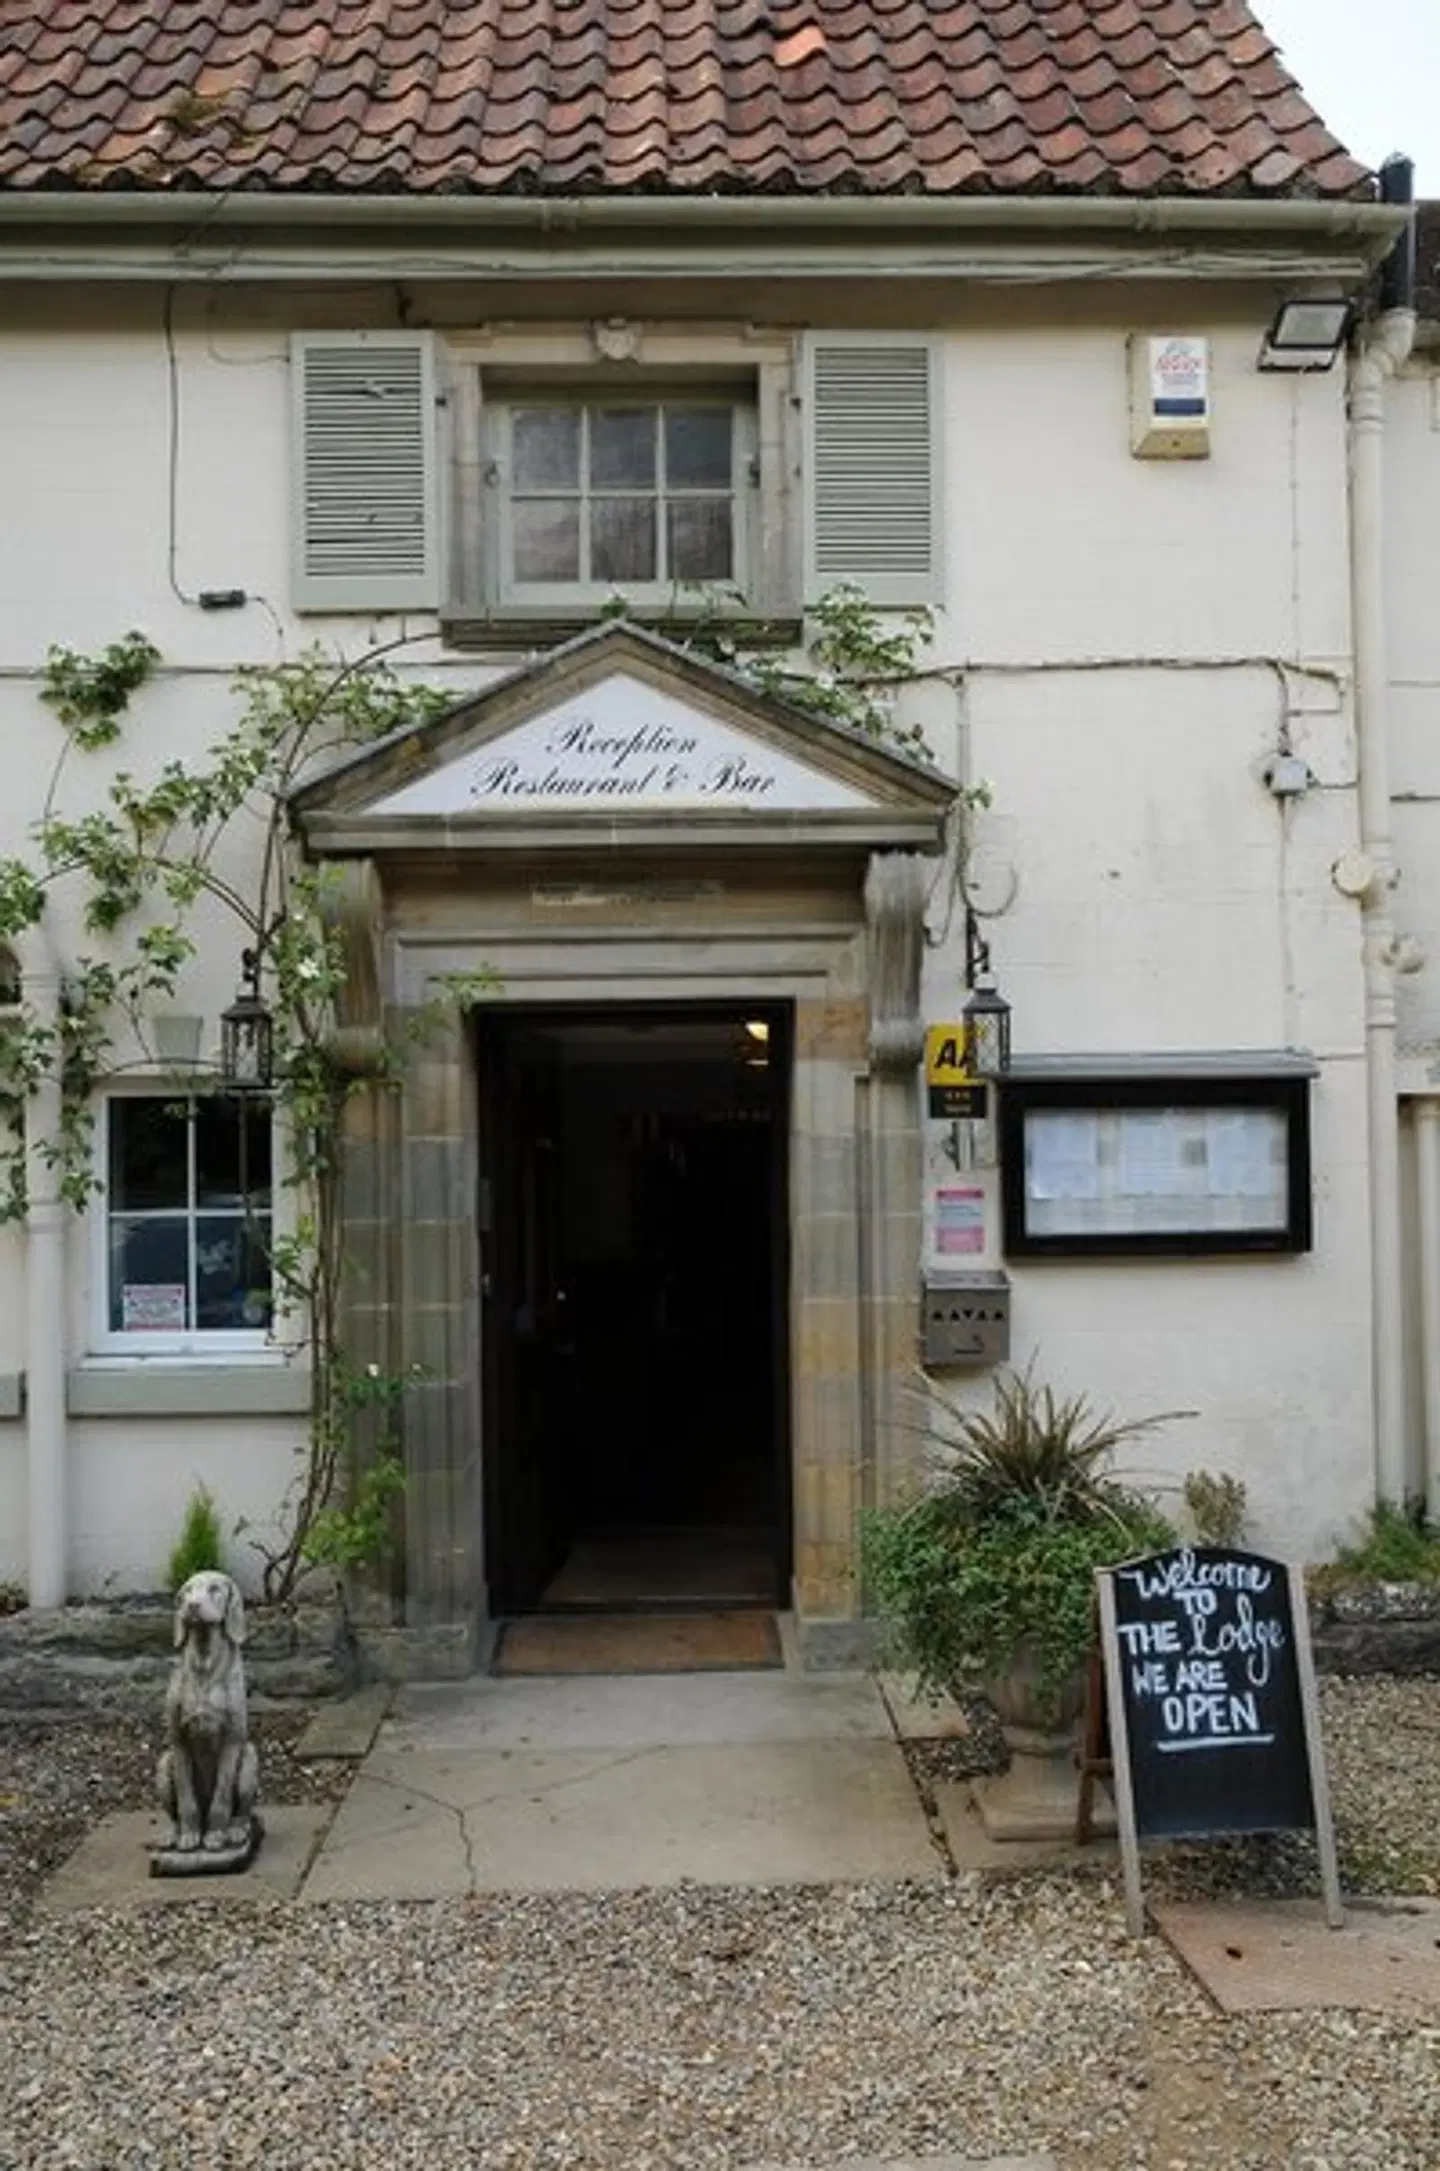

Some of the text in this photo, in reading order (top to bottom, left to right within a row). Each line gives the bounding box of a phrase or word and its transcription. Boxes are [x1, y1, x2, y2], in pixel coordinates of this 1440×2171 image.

[545, 720, 699, 769] Reception
[469, 753, 778, 796] Restaurant & Bar
[1118, 1549, 1271, 1599] Welcome
[1172, 1588, 1218, 1616] TO
[1117, 1621, 1182, 1656] THE
[1131, 1659, 1229, 1696] WE ARE
[1162, 1691, 1261, 1734] OPEN
